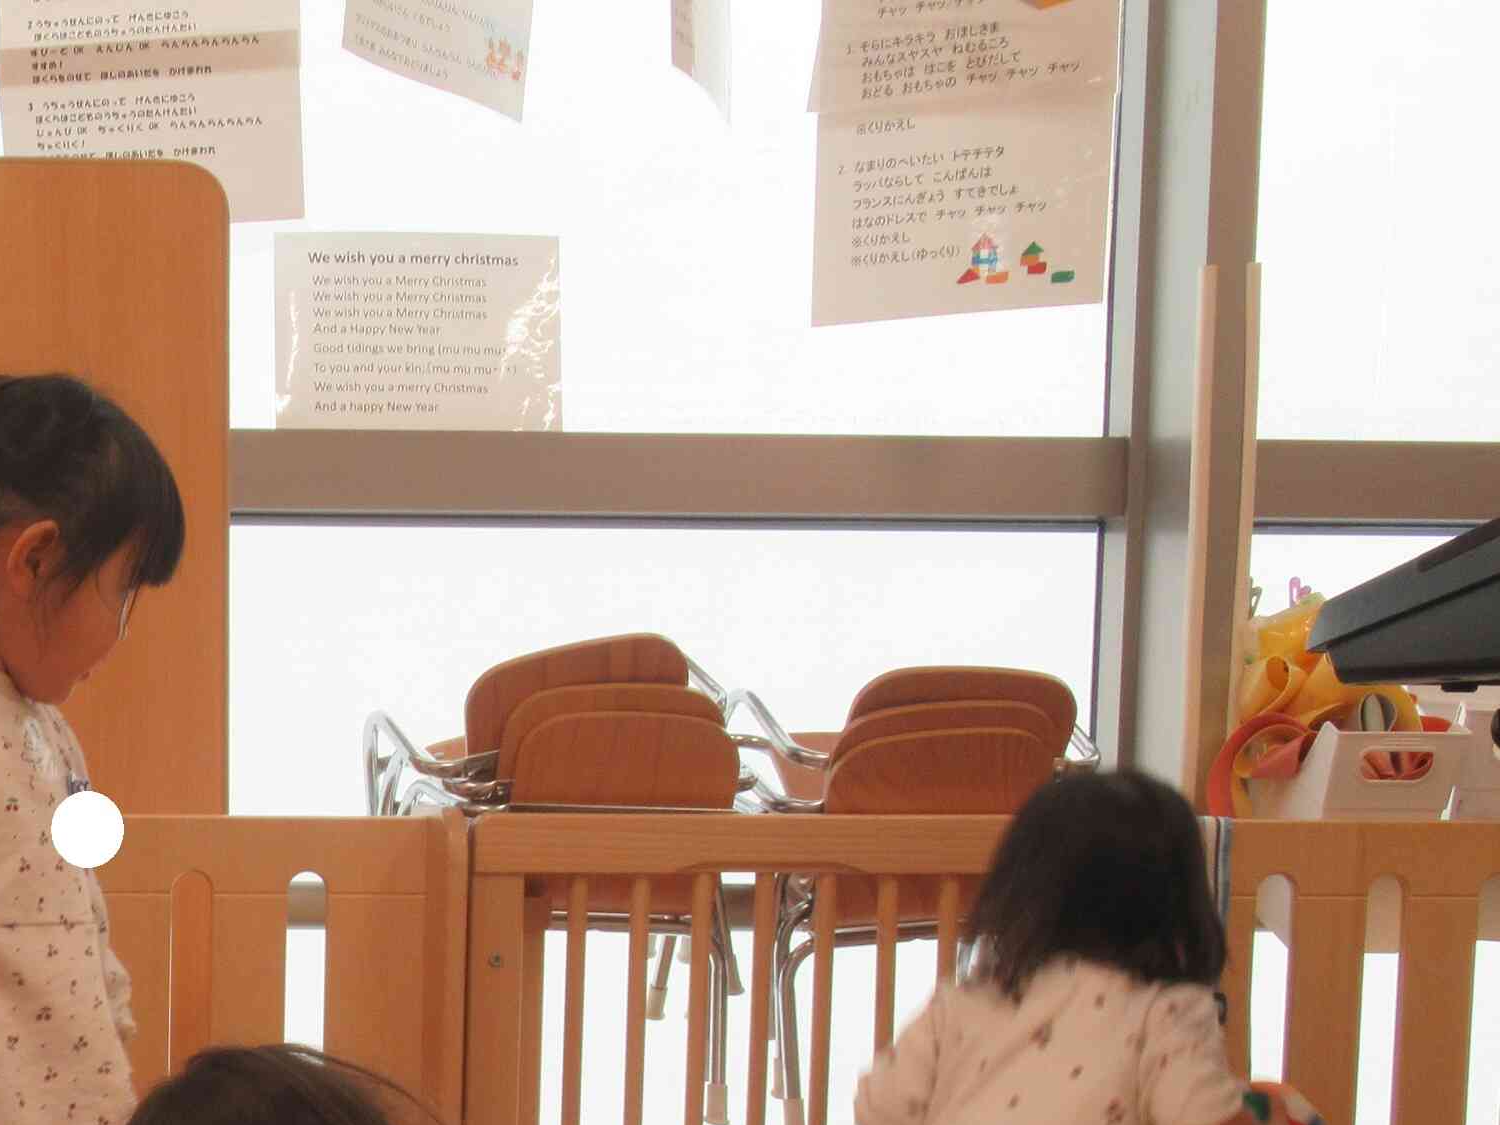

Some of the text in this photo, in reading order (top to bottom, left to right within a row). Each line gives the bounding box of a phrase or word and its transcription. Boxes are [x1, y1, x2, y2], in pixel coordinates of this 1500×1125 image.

[854, 152, 944, 173] なまりのへいたい
[308, 252, 330, 264] We
[334, 251, 364, 264] wish
[370, 255, 395, 266] you
[410, 255, 450, 267] merry
[455, 253, 519, 266] christmas
[313, 276, 331, 286] We
[334, 275, 359, 286] wish
[362, 277, 382, 288] you
[396, 276, 428, 288] Merry
[432, 276, 487, 288] Christmas
[313, 292, 331, 302] We
[335, 291, 359, 302] wish
[363, 294, 382, 304] you
[396, 292, 429, 304] Merry
[432, 292, 487, 304] Christmas
[313, 308, 331, 318] We
[335, 308, 359, 318] wish
[364, 310, 383, 320] you
[396, 308, 429, 320] Merry
[433, 308, 488, 320] Christmas
[314, 323, 337, 334] And
[350, 324, 385, 336] Happy
[389, 324, 413, 334] New
[417, 325, 441, 335] Year
[314, 343, 343, 353] Good
[348, 343, 384, 355] tidings
[388, 345, 403, 353] we
[407, 343, 435, 356] bring
[463, 347, 480, 355] mu
[314, 363, 325, 373] To
[330, 364, 349, 376] you
[354, 362, 373, 373] and
[377, 364, 402, 376] your
[454, 366, 471, 375] mu
[314, 382, 332, 392] We
[336, 381, 360, 393] wish
[364, 384, 384, 394] you
[397, 384, 430, 395] merry
[434, 382, 488, 394] Christmas
[315, 401, 337, 412] And
[350, 401, 384, 414] happy
[388, 401, 411, 411] New
[416, 401, 439, 412] Year
